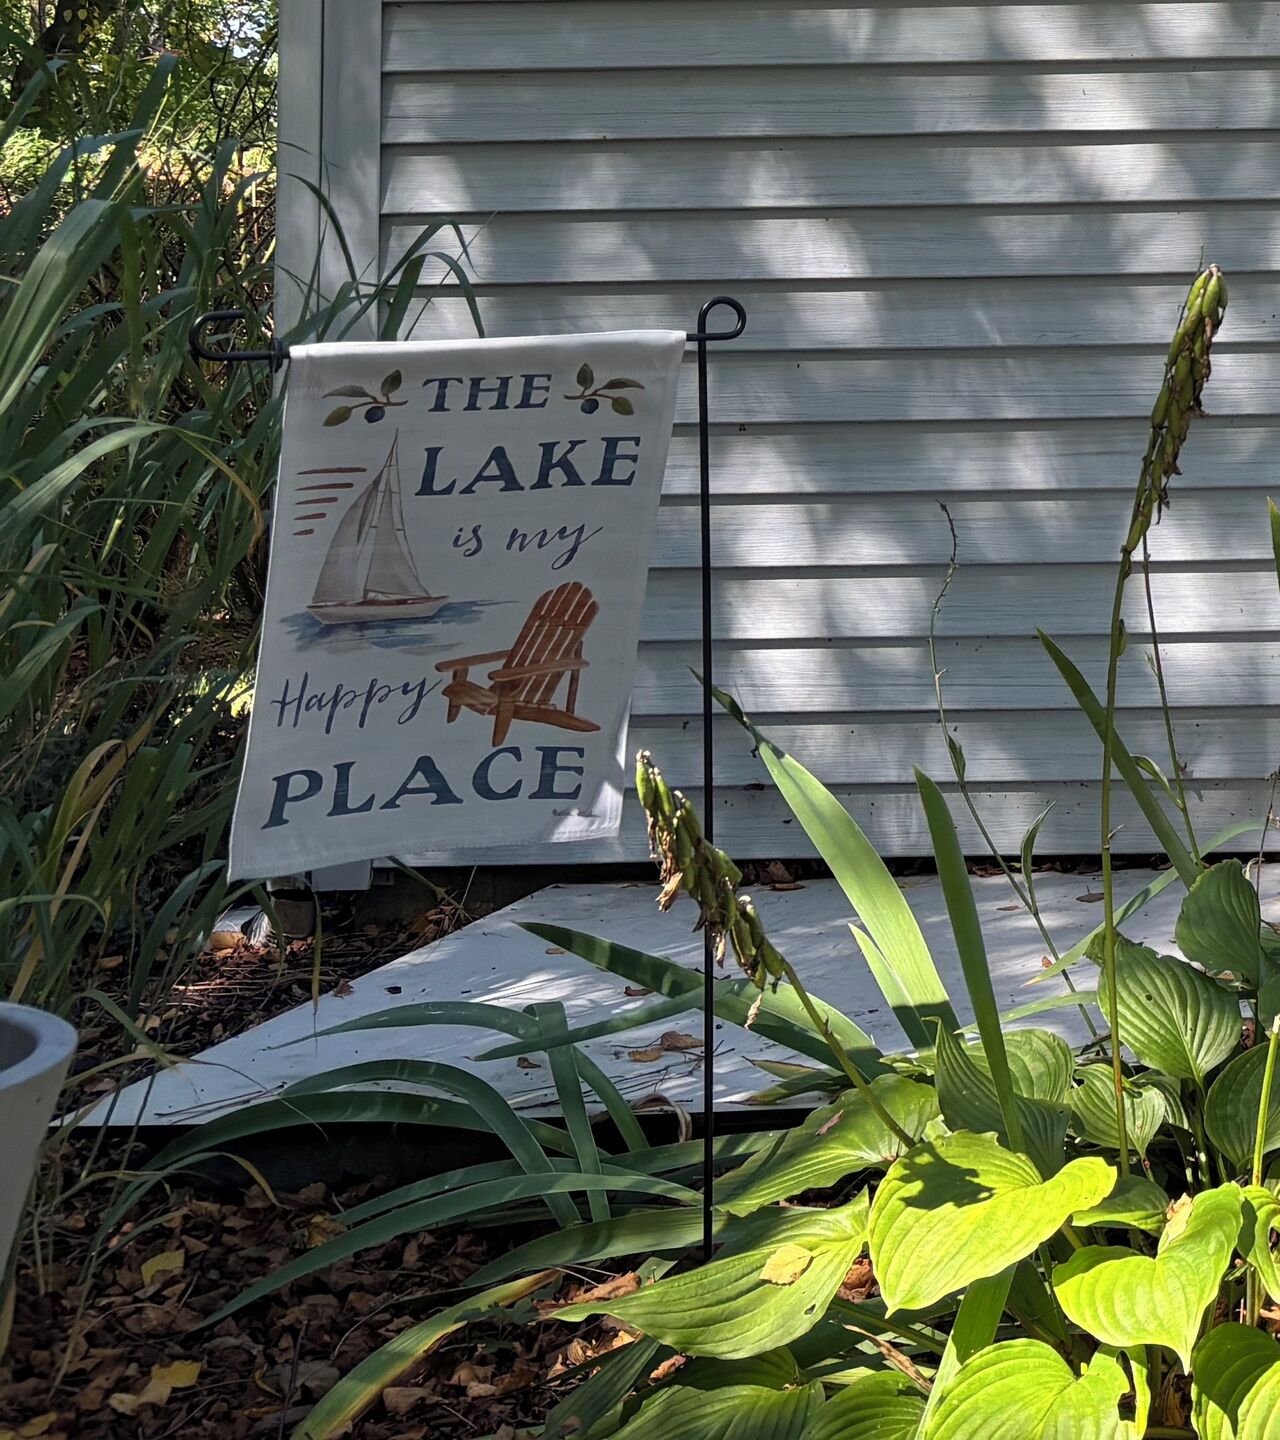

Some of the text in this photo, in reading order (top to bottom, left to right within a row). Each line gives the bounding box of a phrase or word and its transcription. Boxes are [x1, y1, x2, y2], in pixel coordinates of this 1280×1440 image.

[422, 373, 553, 413] THE
[414, 436, 641, 497] LAKE
[452, 522, 604, 571] is my
[270, 671, 443, 735] Happy
[261, 745, 588, 831] PLACE
